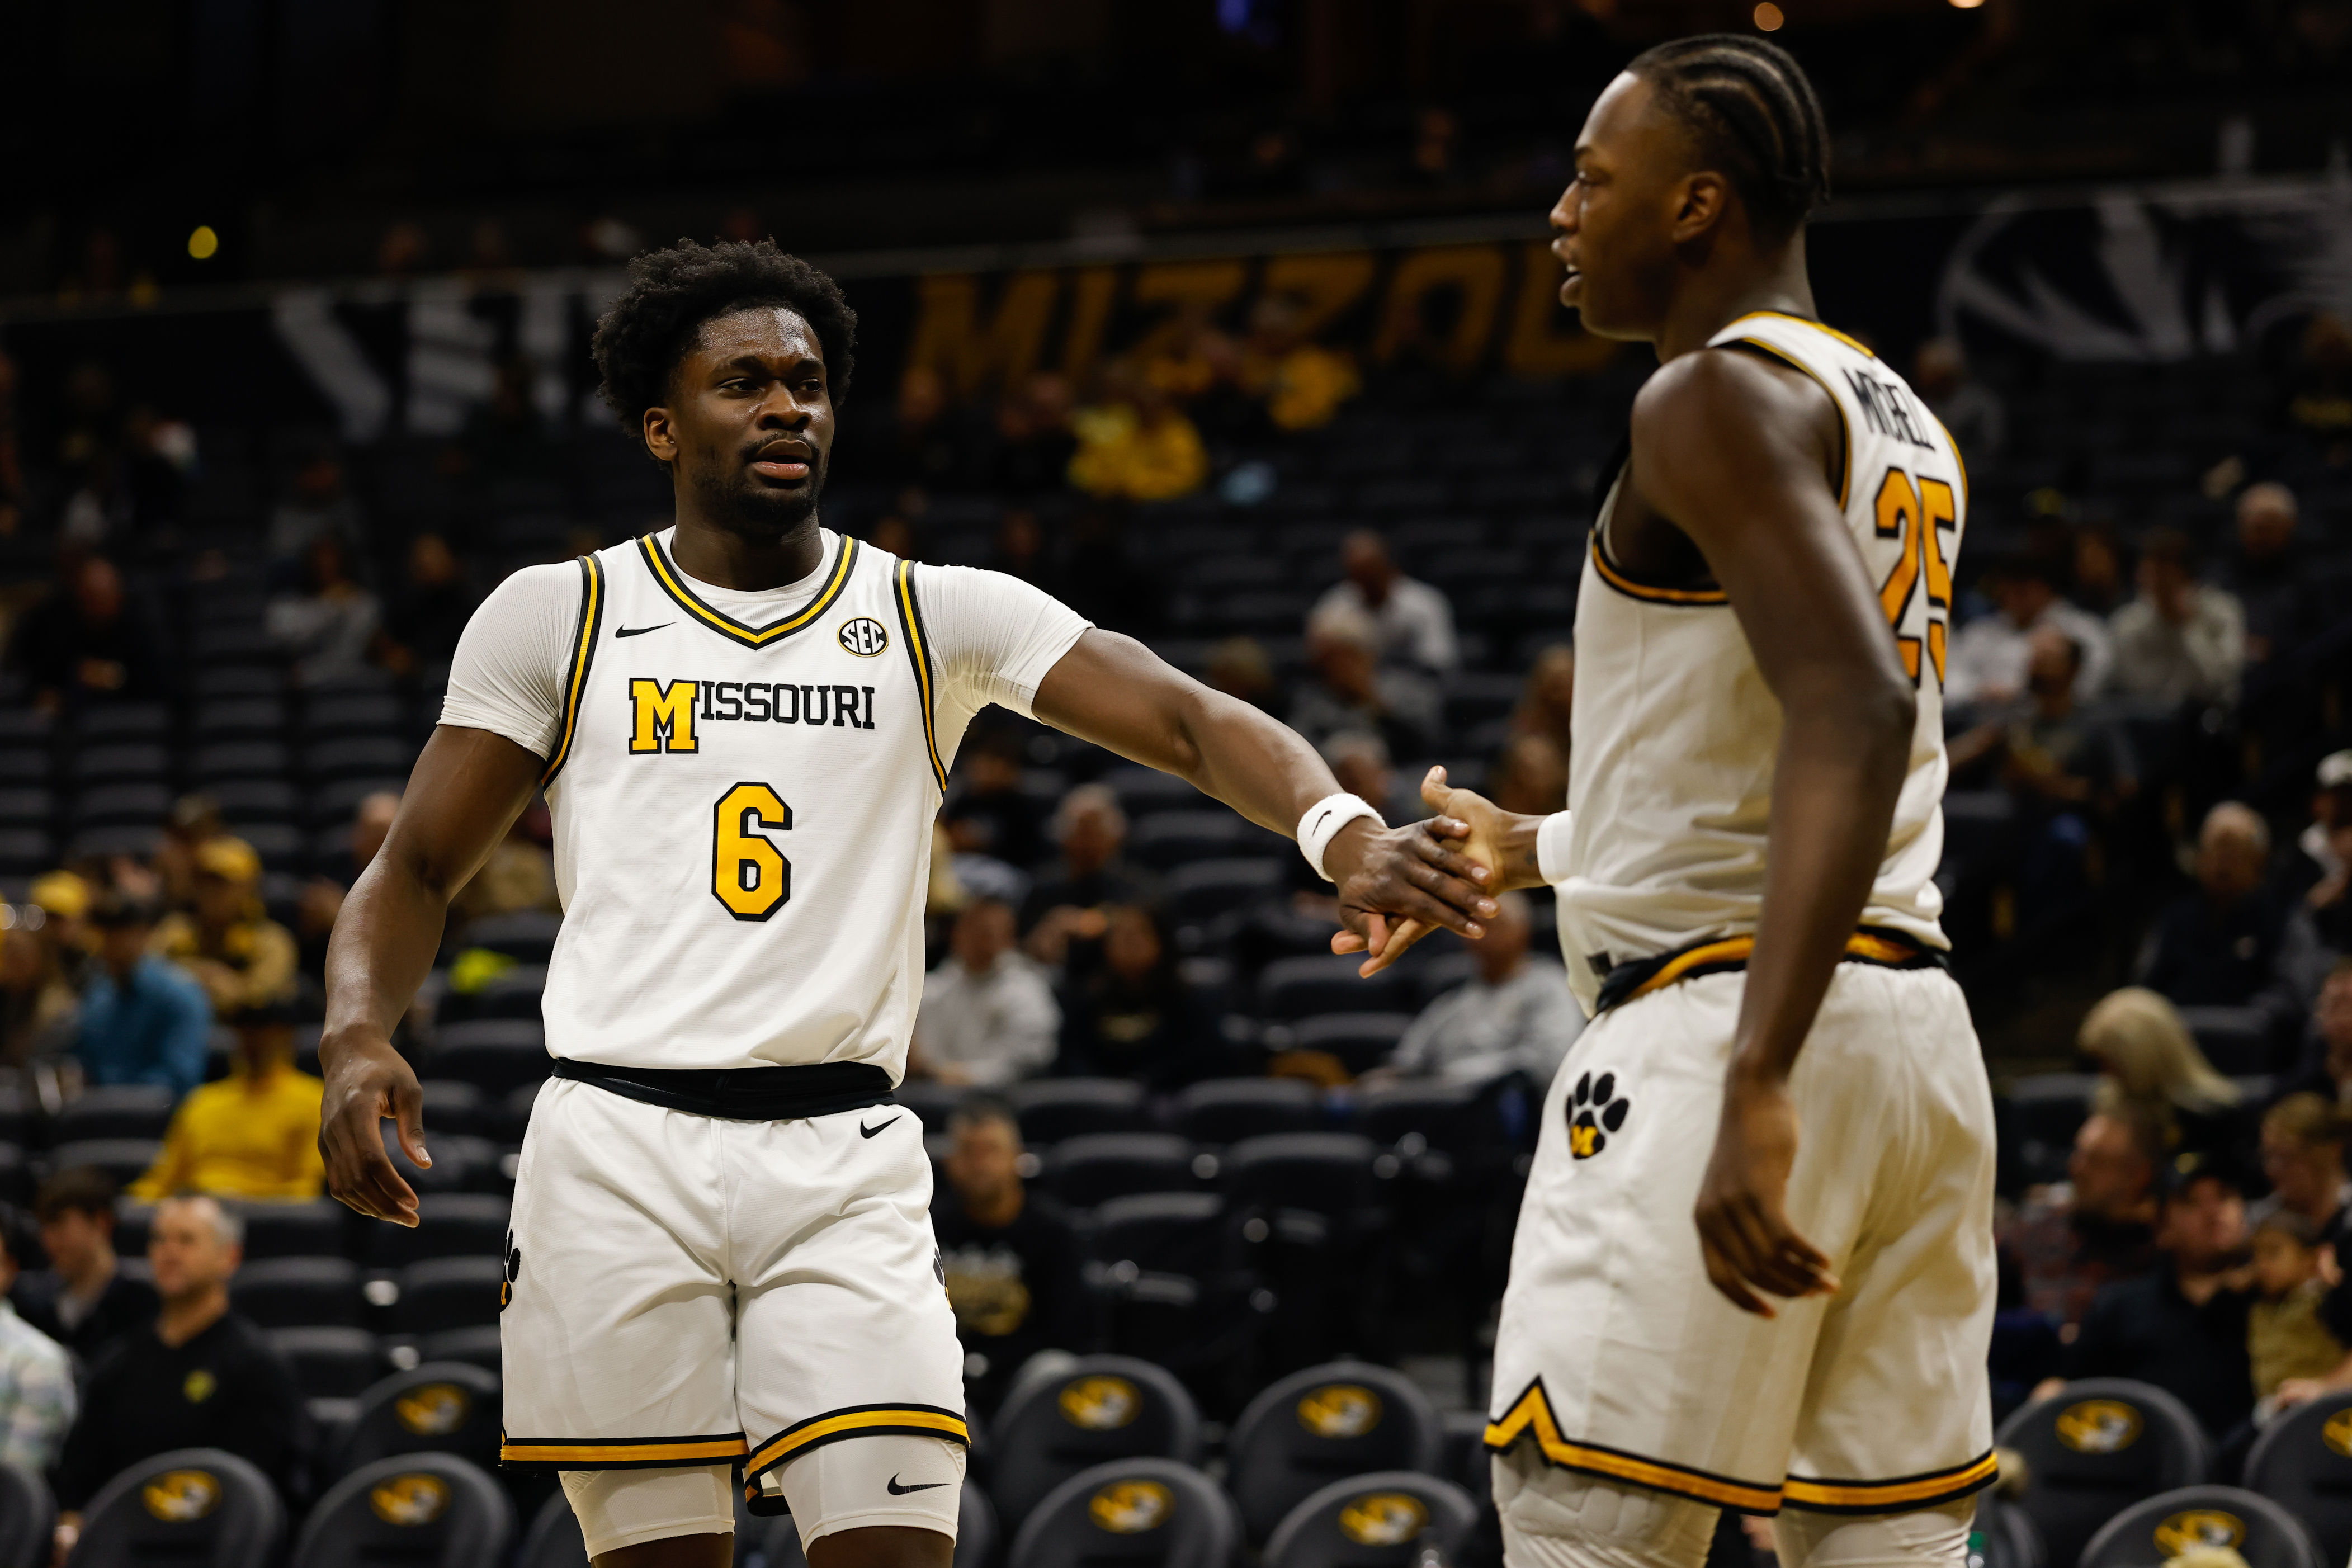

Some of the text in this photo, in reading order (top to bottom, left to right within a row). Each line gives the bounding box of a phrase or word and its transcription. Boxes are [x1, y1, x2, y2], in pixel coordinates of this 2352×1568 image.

[1874, 466, 1956, 695] 25
[841, 619, 885, 654] SEC
[629, 678, 875, 755] MISSOURI
[711, 781, 792, 922] 6
